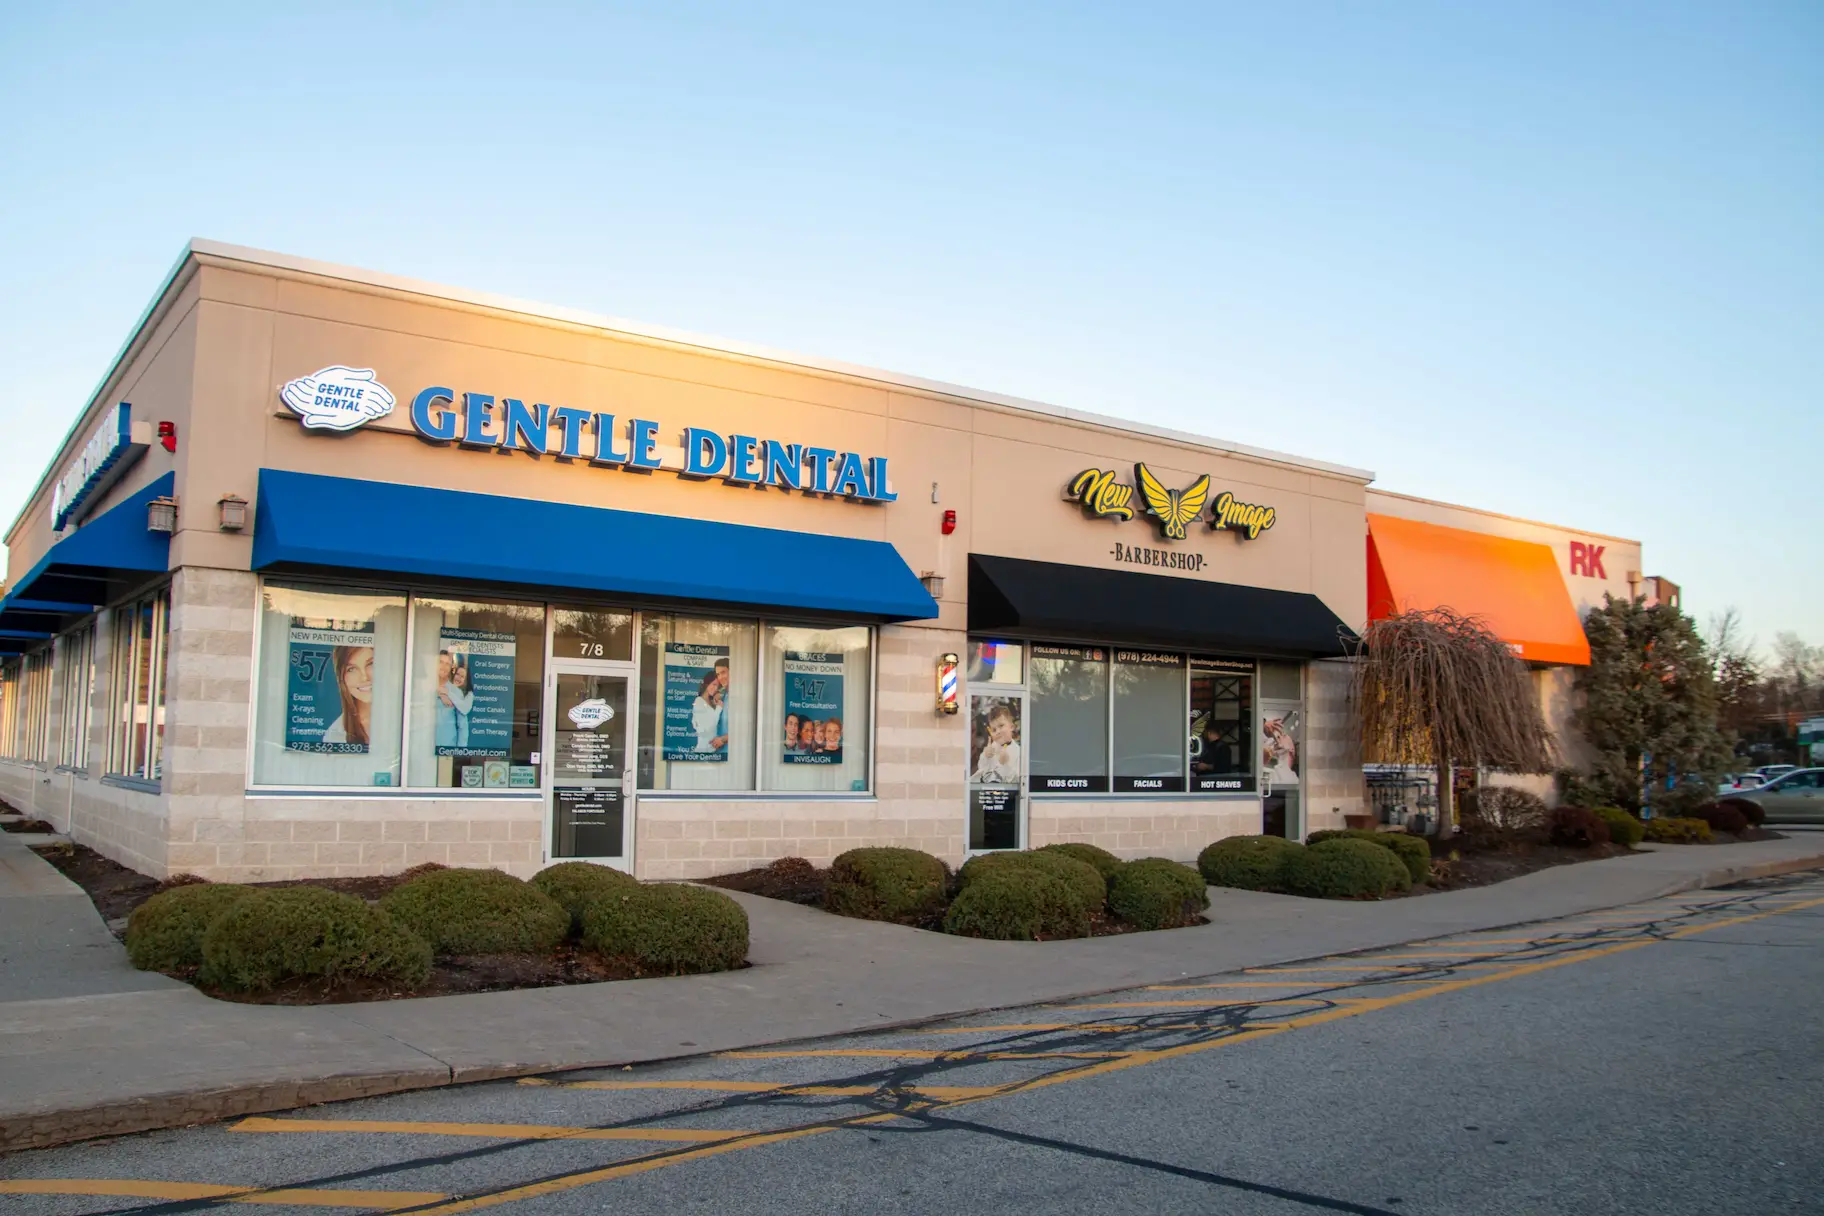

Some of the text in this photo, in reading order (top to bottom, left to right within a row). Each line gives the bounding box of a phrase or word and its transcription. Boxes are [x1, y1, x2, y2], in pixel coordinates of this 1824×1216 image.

[317, 383, 365, 400] GENTLE
[314, 394, 361, 412] DENTAL
[410, 385, 899, 502] GENTLE DENTAL
[1069, 467, 1277, 541] New Image
[1569, 540, 1608, 580] RK
[291, 631, 373, 645] NEW PATIENT OFFER
[479, 632, 497, 640] Dental
[497, 634, 516, 642] Group
[580, 642, 604, 657] 7/8
[673, 644, 718, 655] Gentle Dental
[1033, 646, 1059, 655] FOLLOW
[1060, 647, 1069, 655] US
[1117, 651, 1179, 664] (978) 224-4944
[291, 649, 333, 682] $57
[488, 661, 510, 669] Surgery
[785, 663, 842, 673] NO MONEY DOWN
[474, 672, 511, 681] Orthodontics
[473, 683, 509, 692] Periodontics
[293, 693, 313, 701] Exam
[292, 704, 316, 714] X-rays
[487, 706, 506, 714] Canals
[789, 701, 837, 710] Free Consultation
[291, 716, 324, 726] Cleaning
[486, 728, 508, 736] Therapy
[291, 741, 363, 753] 978-562-3330
[438, 747, 507, 757] GentleDental.com
[794, 755, 831, 763] INVISALIGN
[1047, 779, 1088, 788] KIDS CUTS
[1133, 780, 1162, 788] FACIALS
